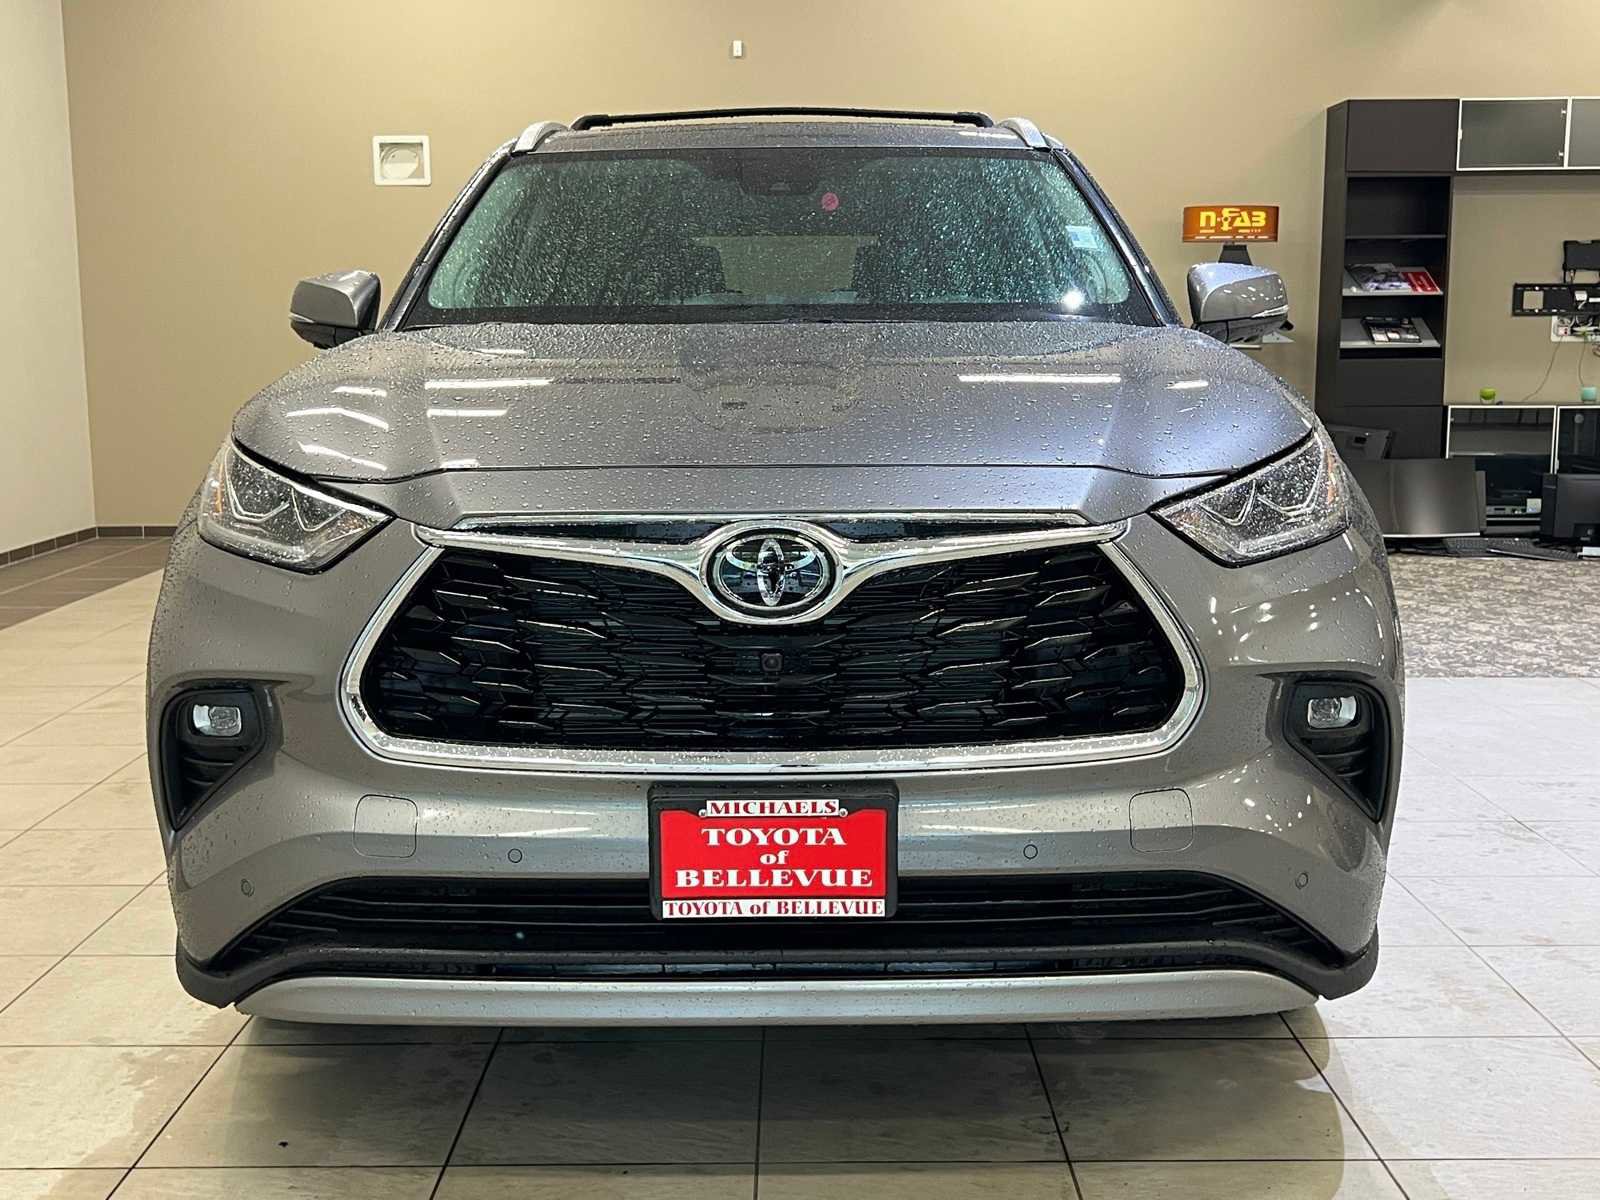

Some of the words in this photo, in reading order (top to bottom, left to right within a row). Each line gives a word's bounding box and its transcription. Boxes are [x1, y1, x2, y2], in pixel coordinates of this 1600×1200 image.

[710, 801, 836, 815] MICHAELS
[701, 828, 847, 846] TOYOTA
[760, 850, 789, 865] of
[675, 869, 873, 888] BELLEVUE
[665, 901, 743, 916] TOYOTA
[750, 901, 771, 915] of
[778, 900, 883, 916] BELLEVUE
